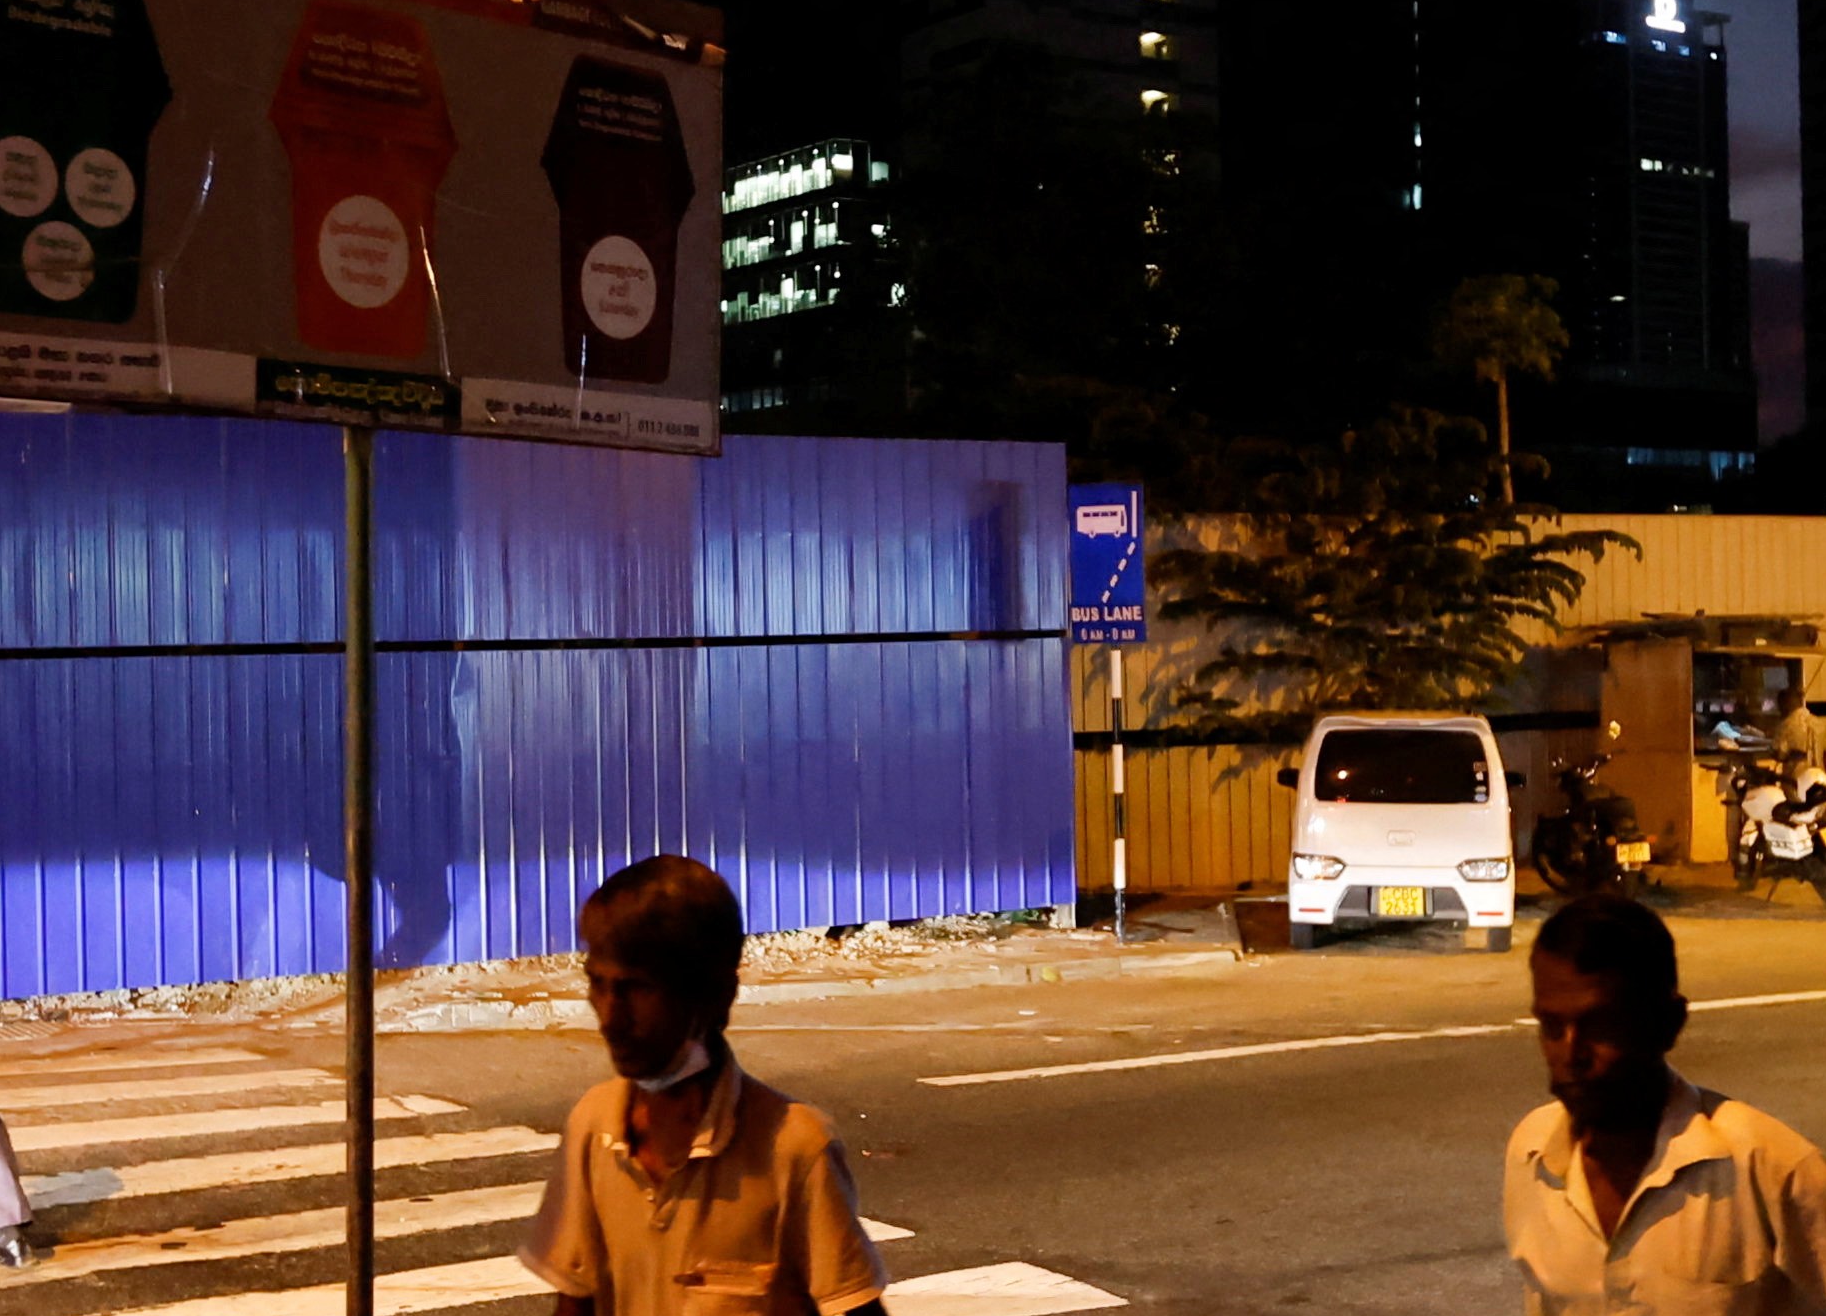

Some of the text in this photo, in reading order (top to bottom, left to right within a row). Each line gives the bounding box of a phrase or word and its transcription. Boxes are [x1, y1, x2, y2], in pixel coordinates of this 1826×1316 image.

[1071, 605, 1143, 622] BUS LANE
[1090, 629, 1104, 641] AM
